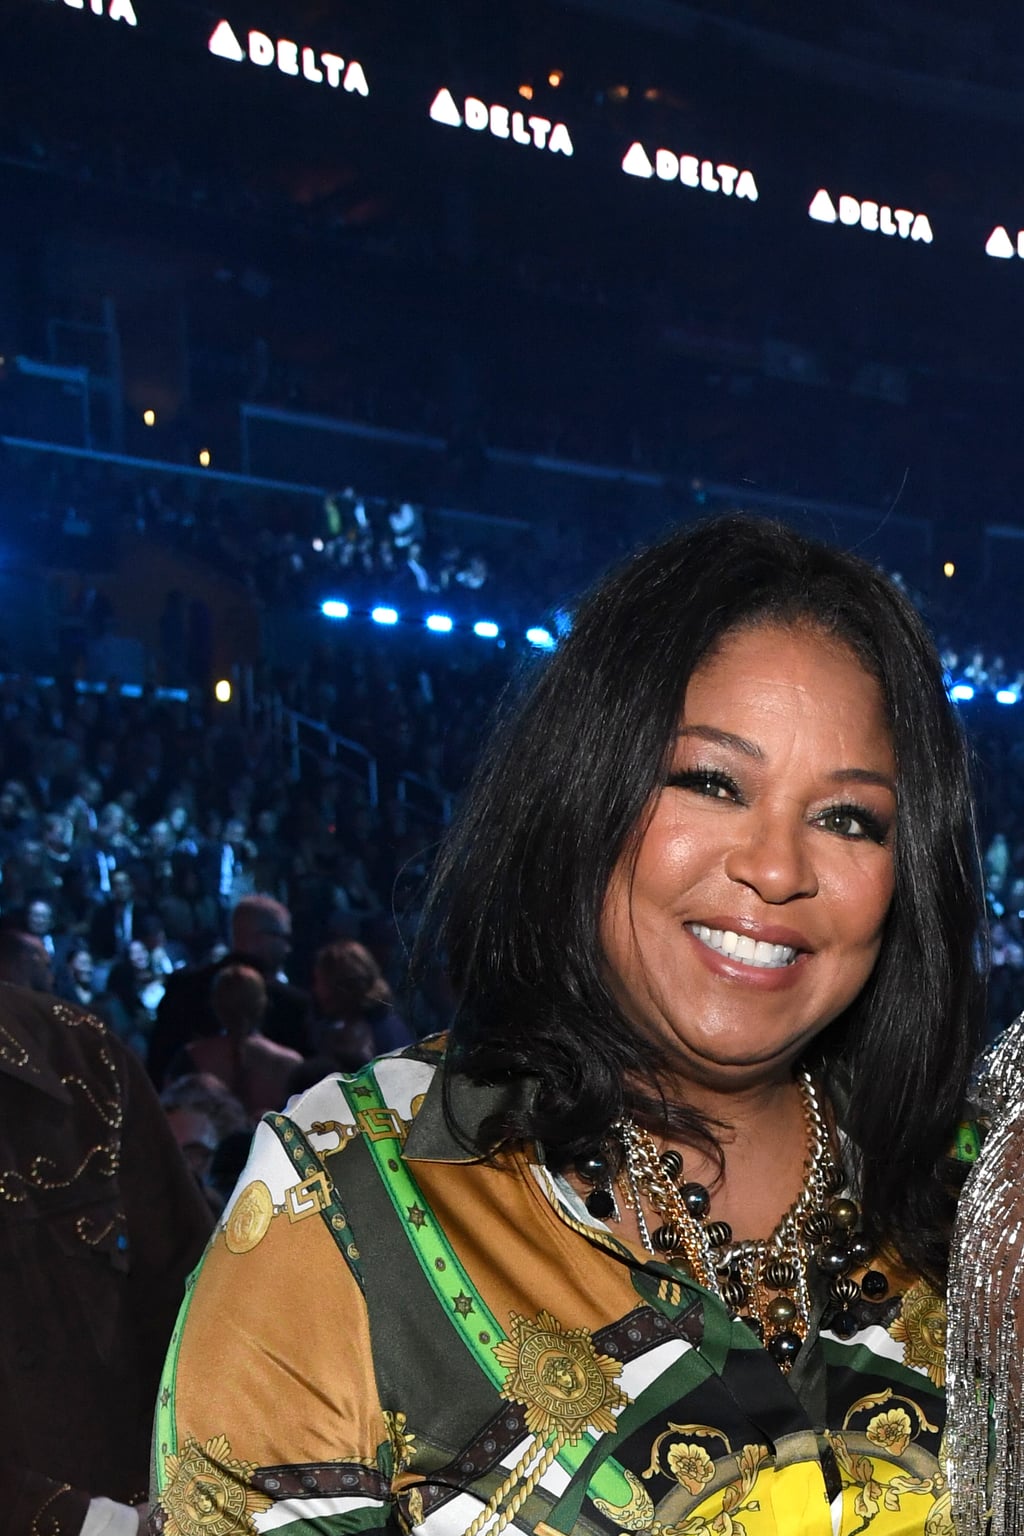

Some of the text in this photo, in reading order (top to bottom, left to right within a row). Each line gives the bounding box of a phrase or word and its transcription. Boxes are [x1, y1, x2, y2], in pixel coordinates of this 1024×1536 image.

[248, 30, 369, 97] DELTA
[464, 97, 574, 157] DELTA
[655, 149, 759, 202] DELTA
[838, 195, 934, 244] DELTA
